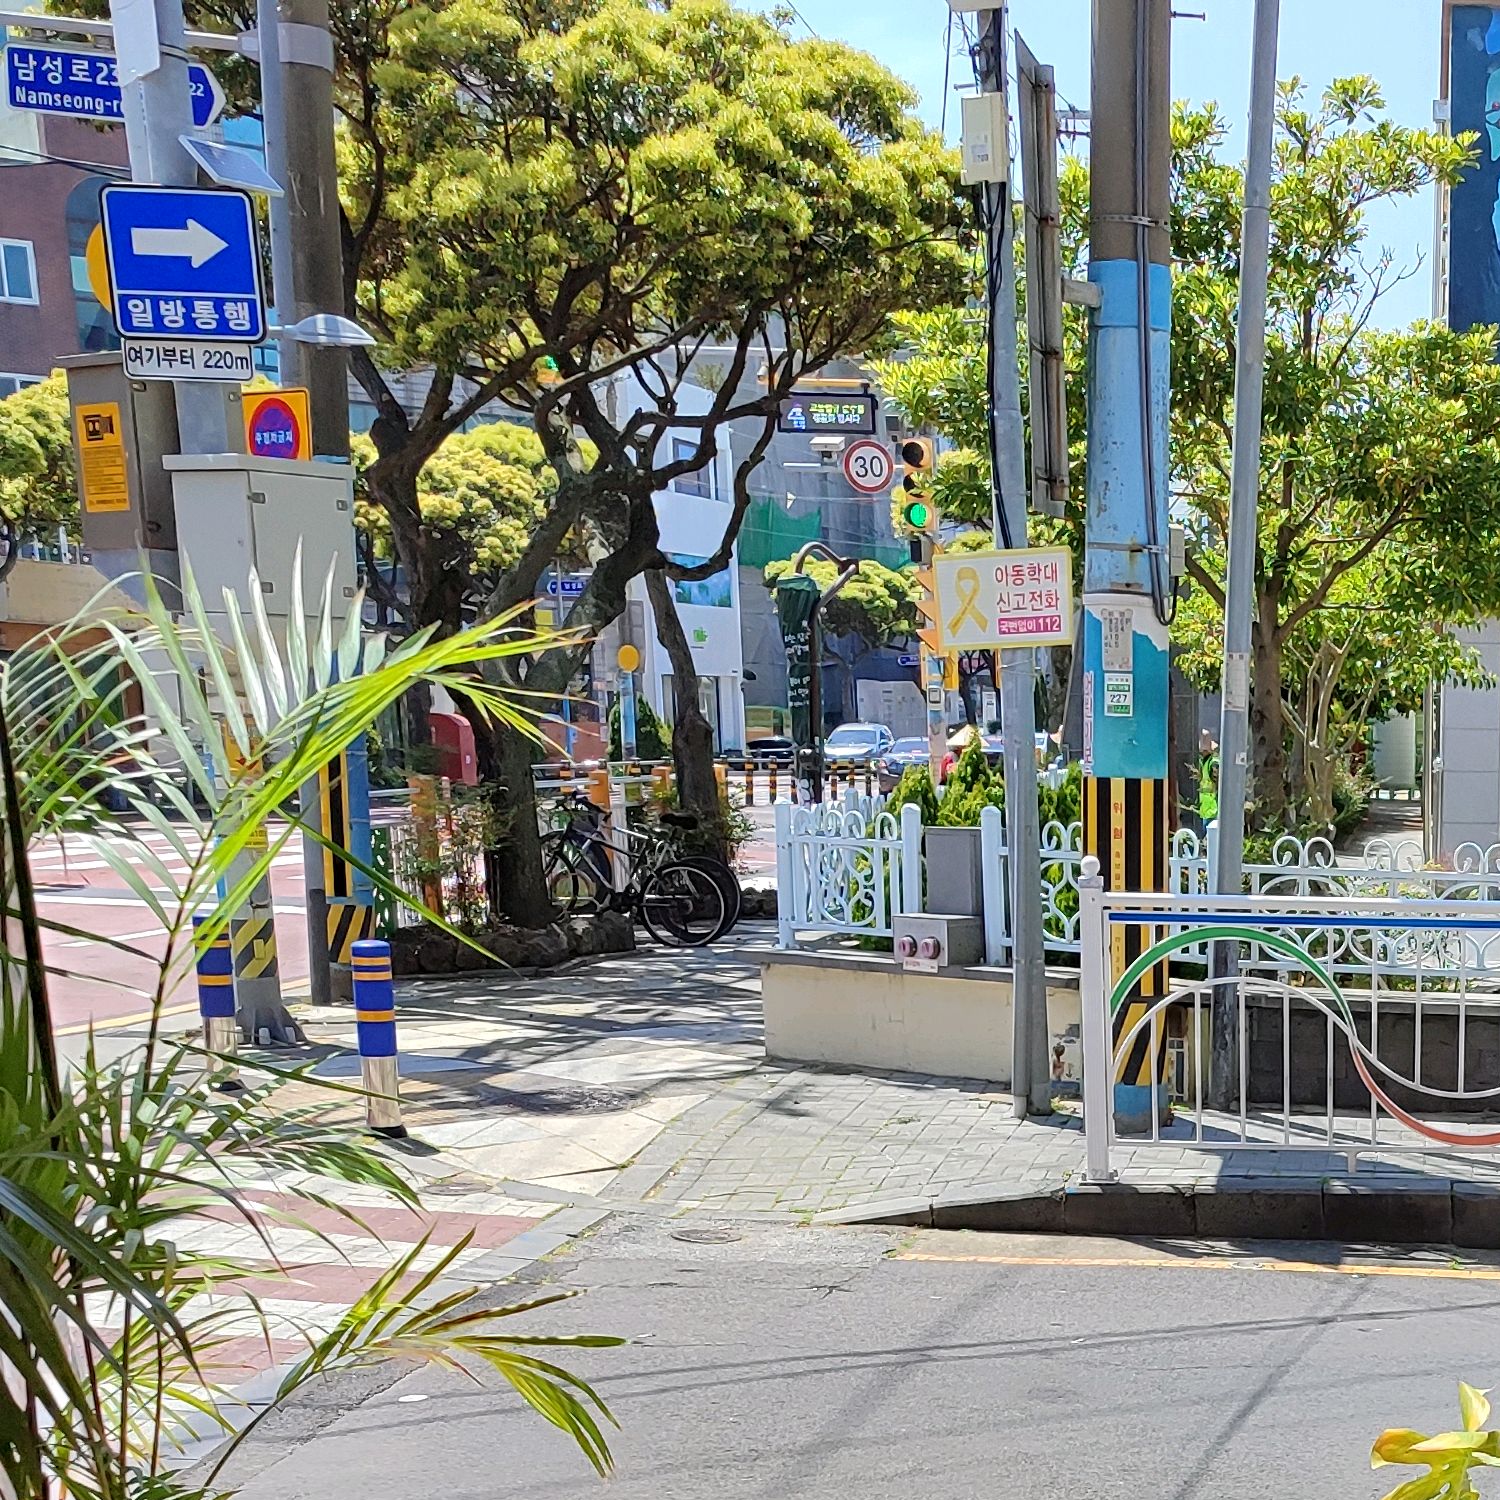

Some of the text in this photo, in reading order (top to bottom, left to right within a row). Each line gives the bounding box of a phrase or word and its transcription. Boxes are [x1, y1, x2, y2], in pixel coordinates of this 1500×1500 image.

[15, 85, 122, 114] Namseong-r
[127, 298, 251, 331] 일방통행
[127, 345, 249, 370] 여기부터 220m
[854, 455, 884, 478] 30
[996, 588, 1060, 614] 신고전화
[1038, 616, 1061, 631] 112
[1110, 693, 1128, 704] 227
